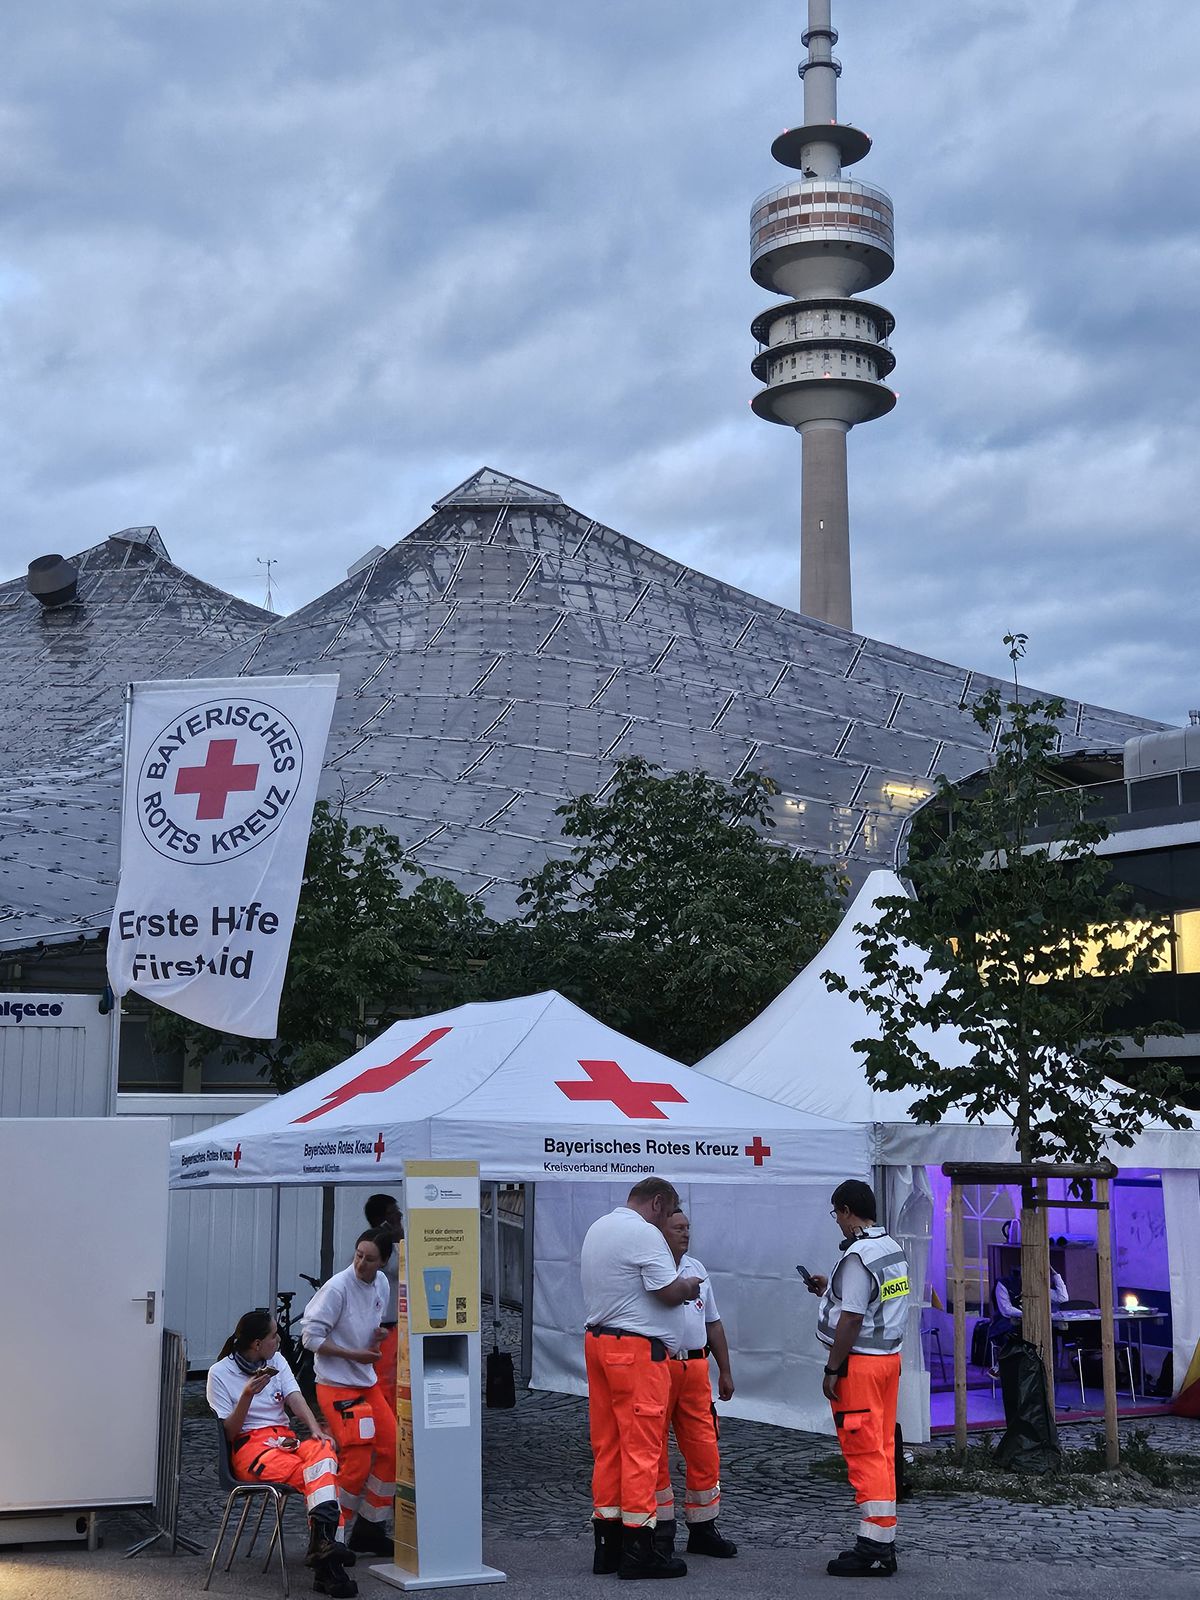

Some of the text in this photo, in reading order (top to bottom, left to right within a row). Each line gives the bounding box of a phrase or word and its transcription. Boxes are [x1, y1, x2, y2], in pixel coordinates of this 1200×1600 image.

[147, 705, 296, 780] BAYERISCHES
[144, 785, 291, 855] ROTES KREUZ
[119, 908, 199, 940] Erste
[0, 1001, 62, 1024] lgeco
[304, 1140, 372, 1159] Bayerisches Rotes Kreuz
[544, 1138, 739, 1157] Bayerisches Rotes Kreuz
[544, 1162, 655, 1173] Kreisverband München
